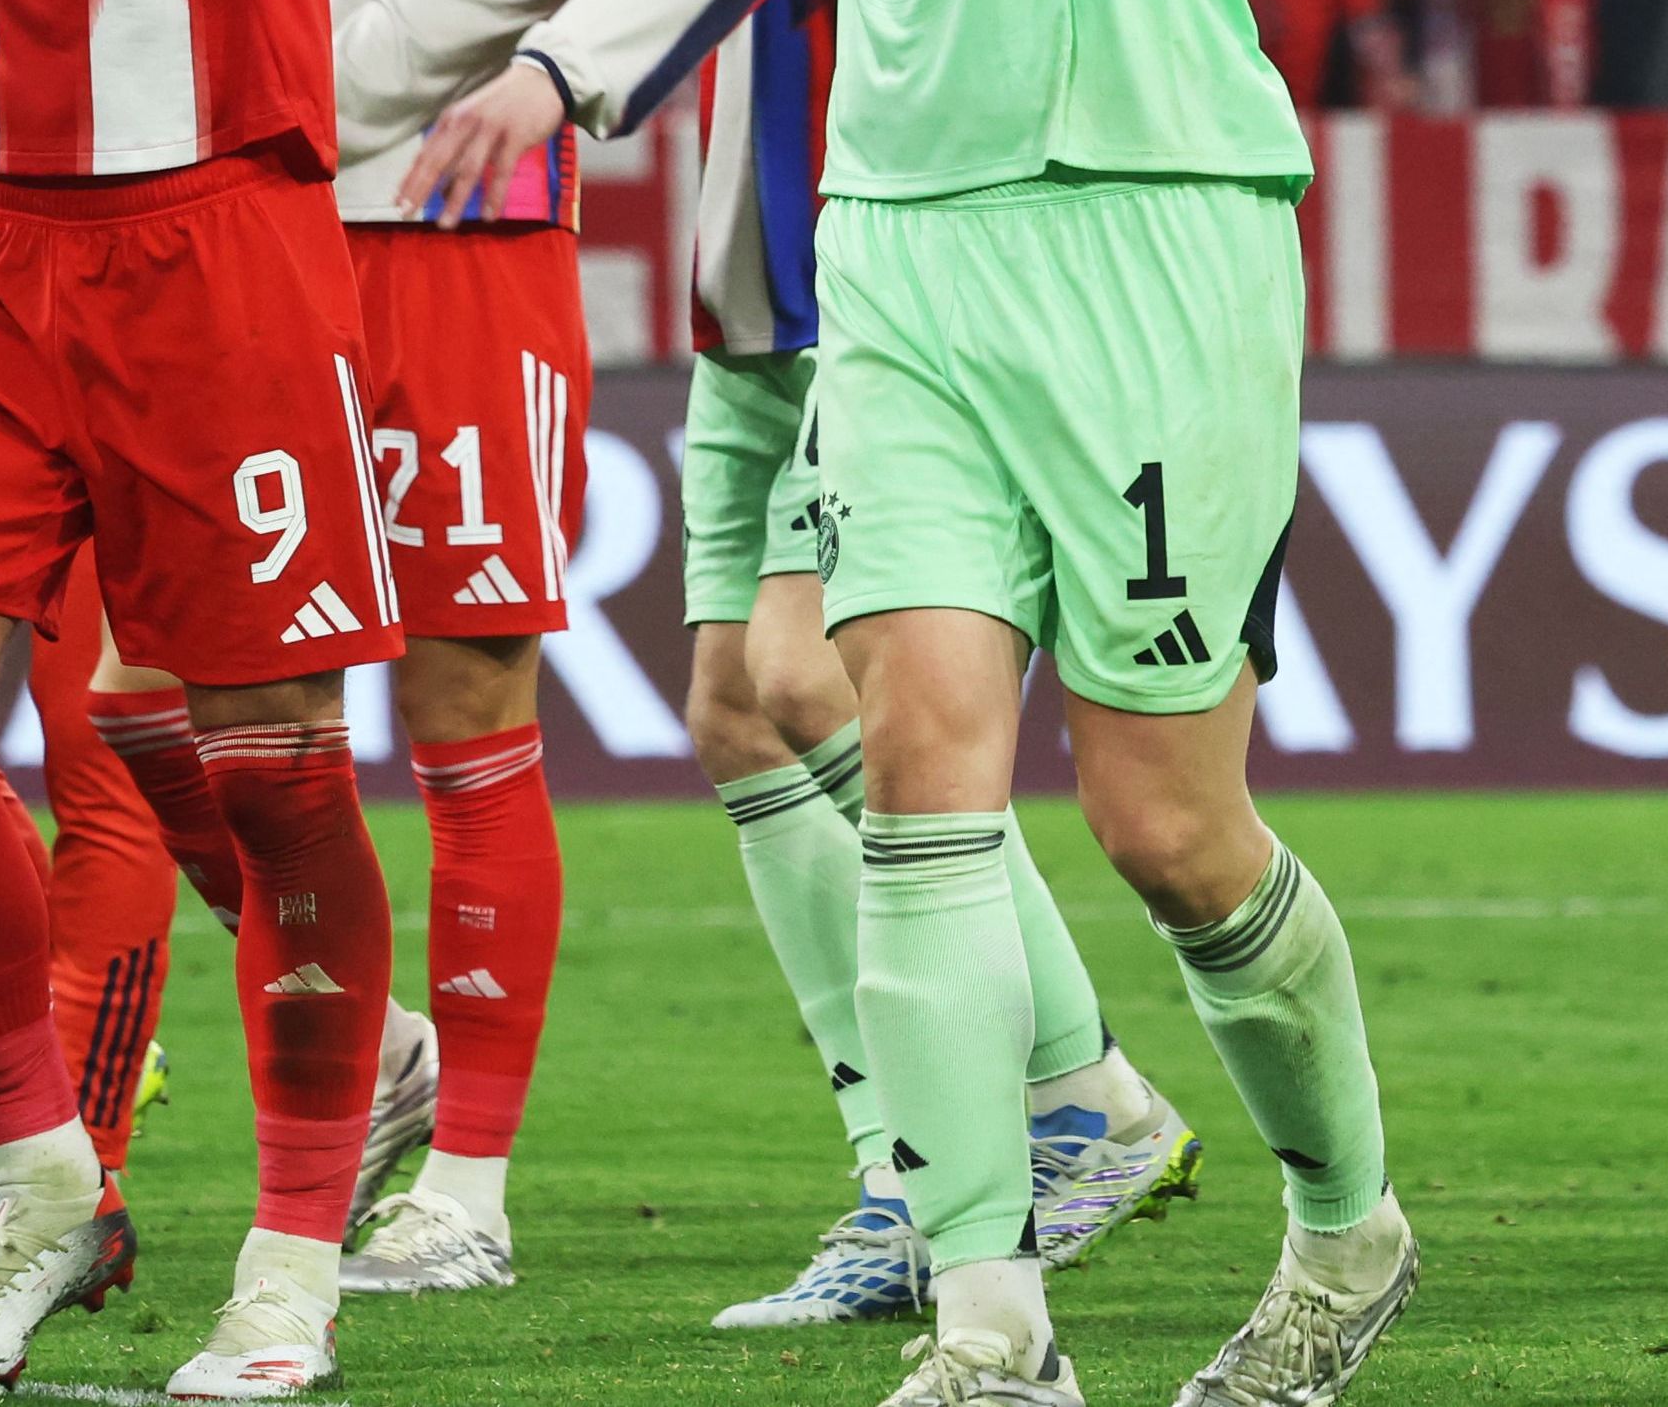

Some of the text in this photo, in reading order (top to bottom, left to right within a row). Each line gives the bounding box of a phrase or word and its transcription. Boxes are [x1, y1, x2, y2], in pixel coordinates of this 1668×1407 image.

[233, 450, 307, 583] 9
[372, 425, 503, 548] 21
[1123, 462, 1187, 600] 1
